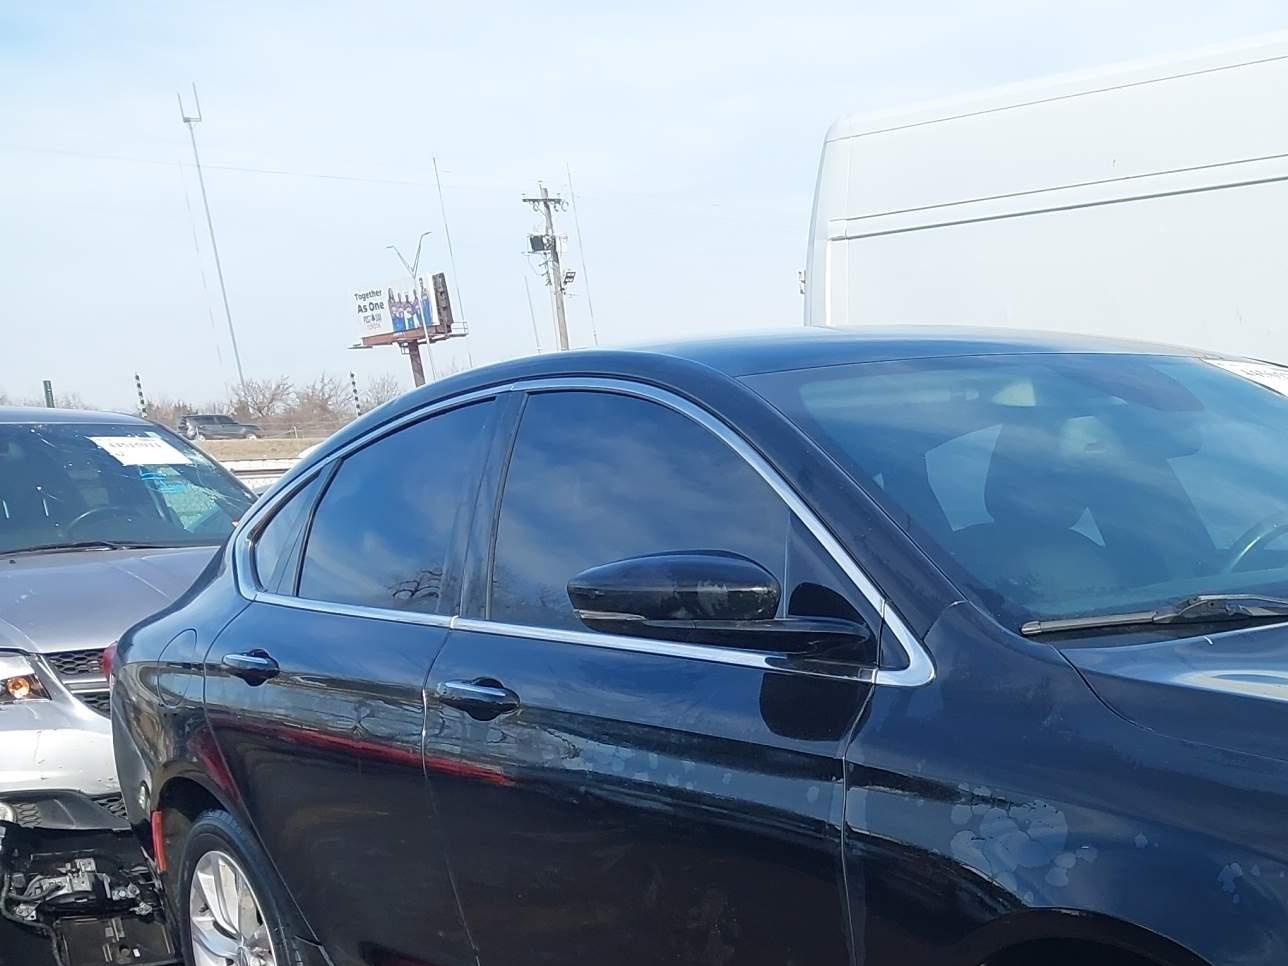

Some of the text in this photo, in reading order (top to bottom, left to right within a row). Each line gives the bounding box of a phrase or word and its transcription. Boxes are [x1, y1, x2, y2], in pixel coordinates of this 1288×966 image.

[354, 289, 382, 302] Together
[357, 301, 385, 314] As One
